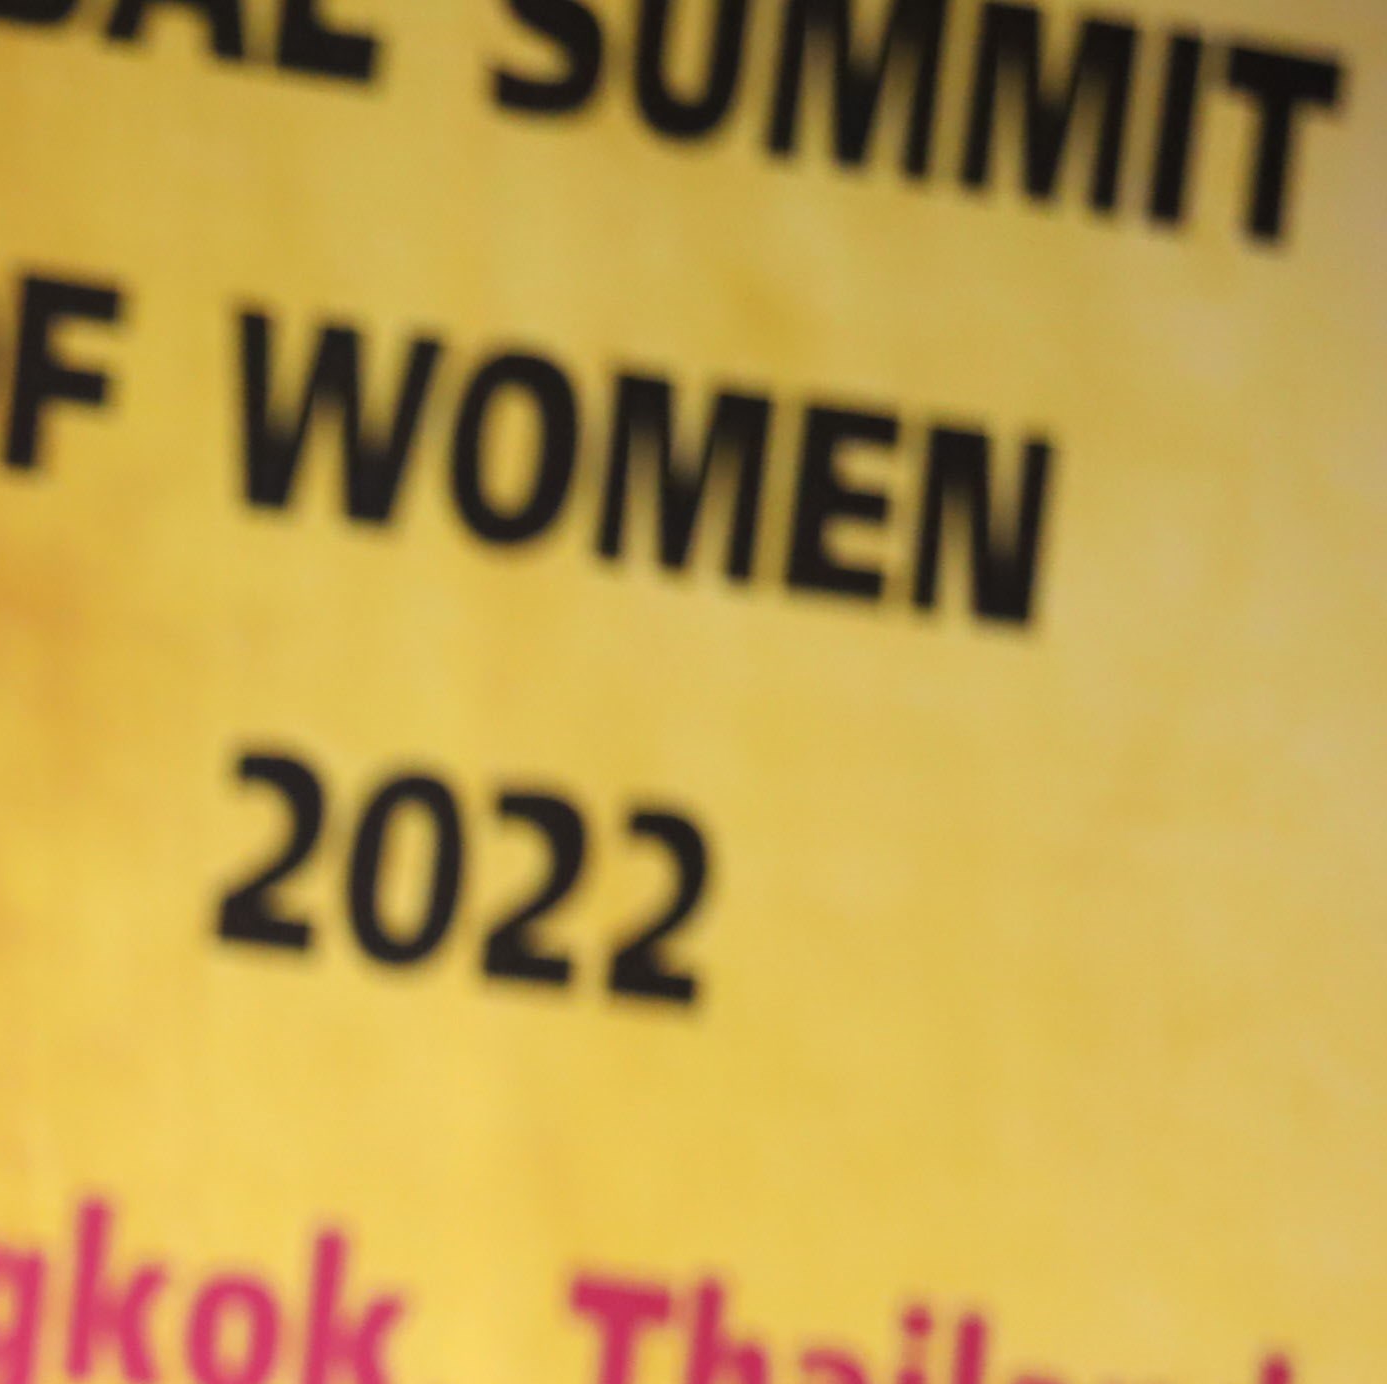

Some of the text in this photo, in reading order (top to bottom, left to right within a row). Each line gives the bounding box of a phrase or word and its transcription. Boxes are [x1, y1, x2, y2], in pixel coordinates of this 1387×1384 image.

[485, 0, 1353, 250] SUMMIT
[233, 305, 1059, 633] WOMEN
[213, 749, 714, 1010] 2022
